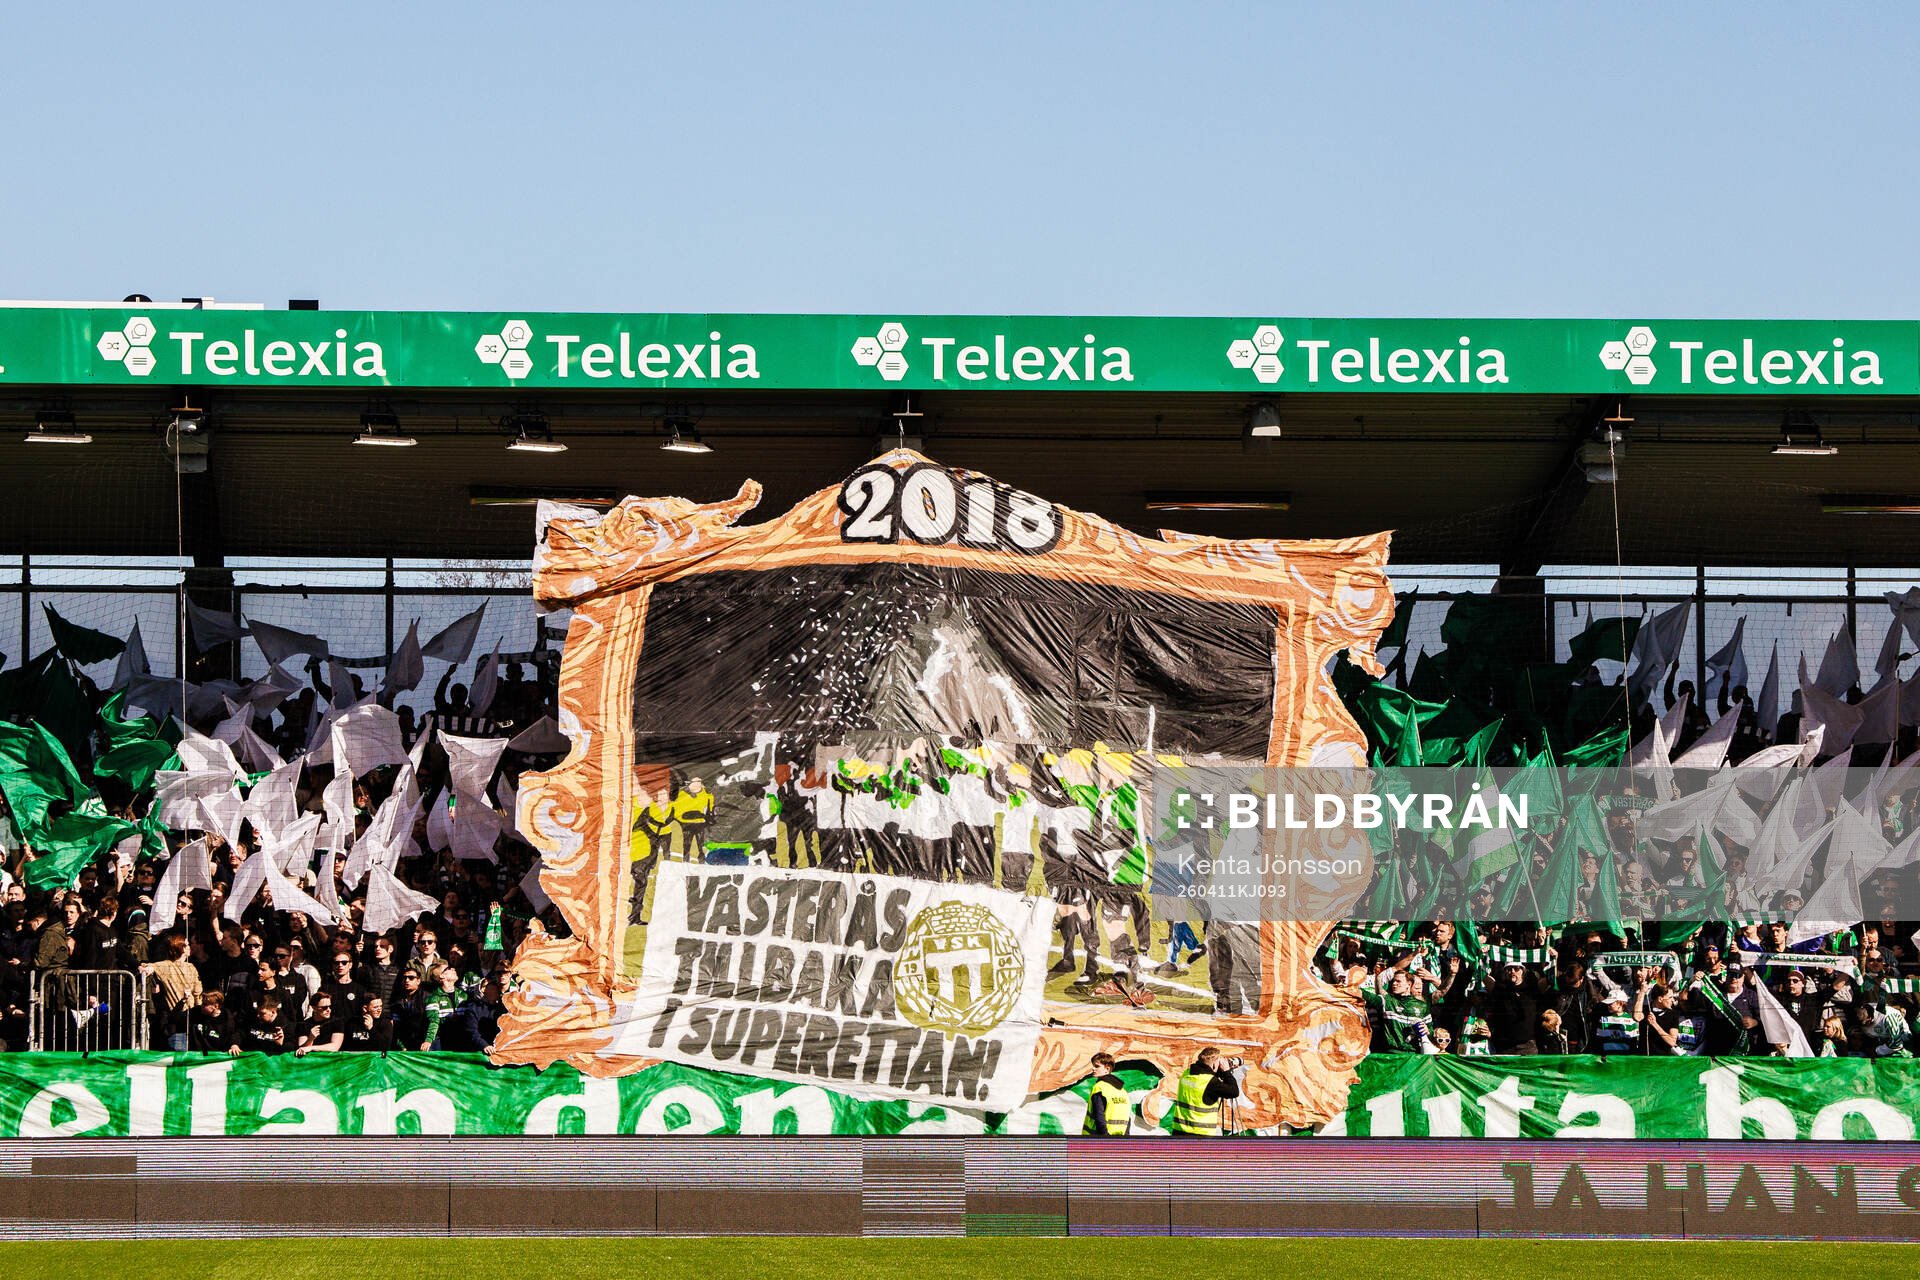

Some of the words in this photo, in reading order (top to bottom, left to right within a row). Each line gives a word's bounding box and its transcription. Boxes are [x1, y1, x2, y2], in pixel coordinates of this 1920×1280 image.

[169, 329, 386, 376] Telexia
[546, 332, 760, 378] Telexia
[922, 334, 1134, 381] Telexia
[1297, 336, 1508, 383] Telexia
[1670, 338, 1883, 384] Telexia
[838, 463, 1062, 555] 2018
[686, 874, 911, 952] VÄSTERÅS
[932, 935, 981, 950] VSK
[672, 936, 897, 1021] TILLBAKA
[904, 963, 917, 973] 19
[648, 999, 682, 1048] I
[678, 1007, 1002, 1101] SUPERETTAN!
